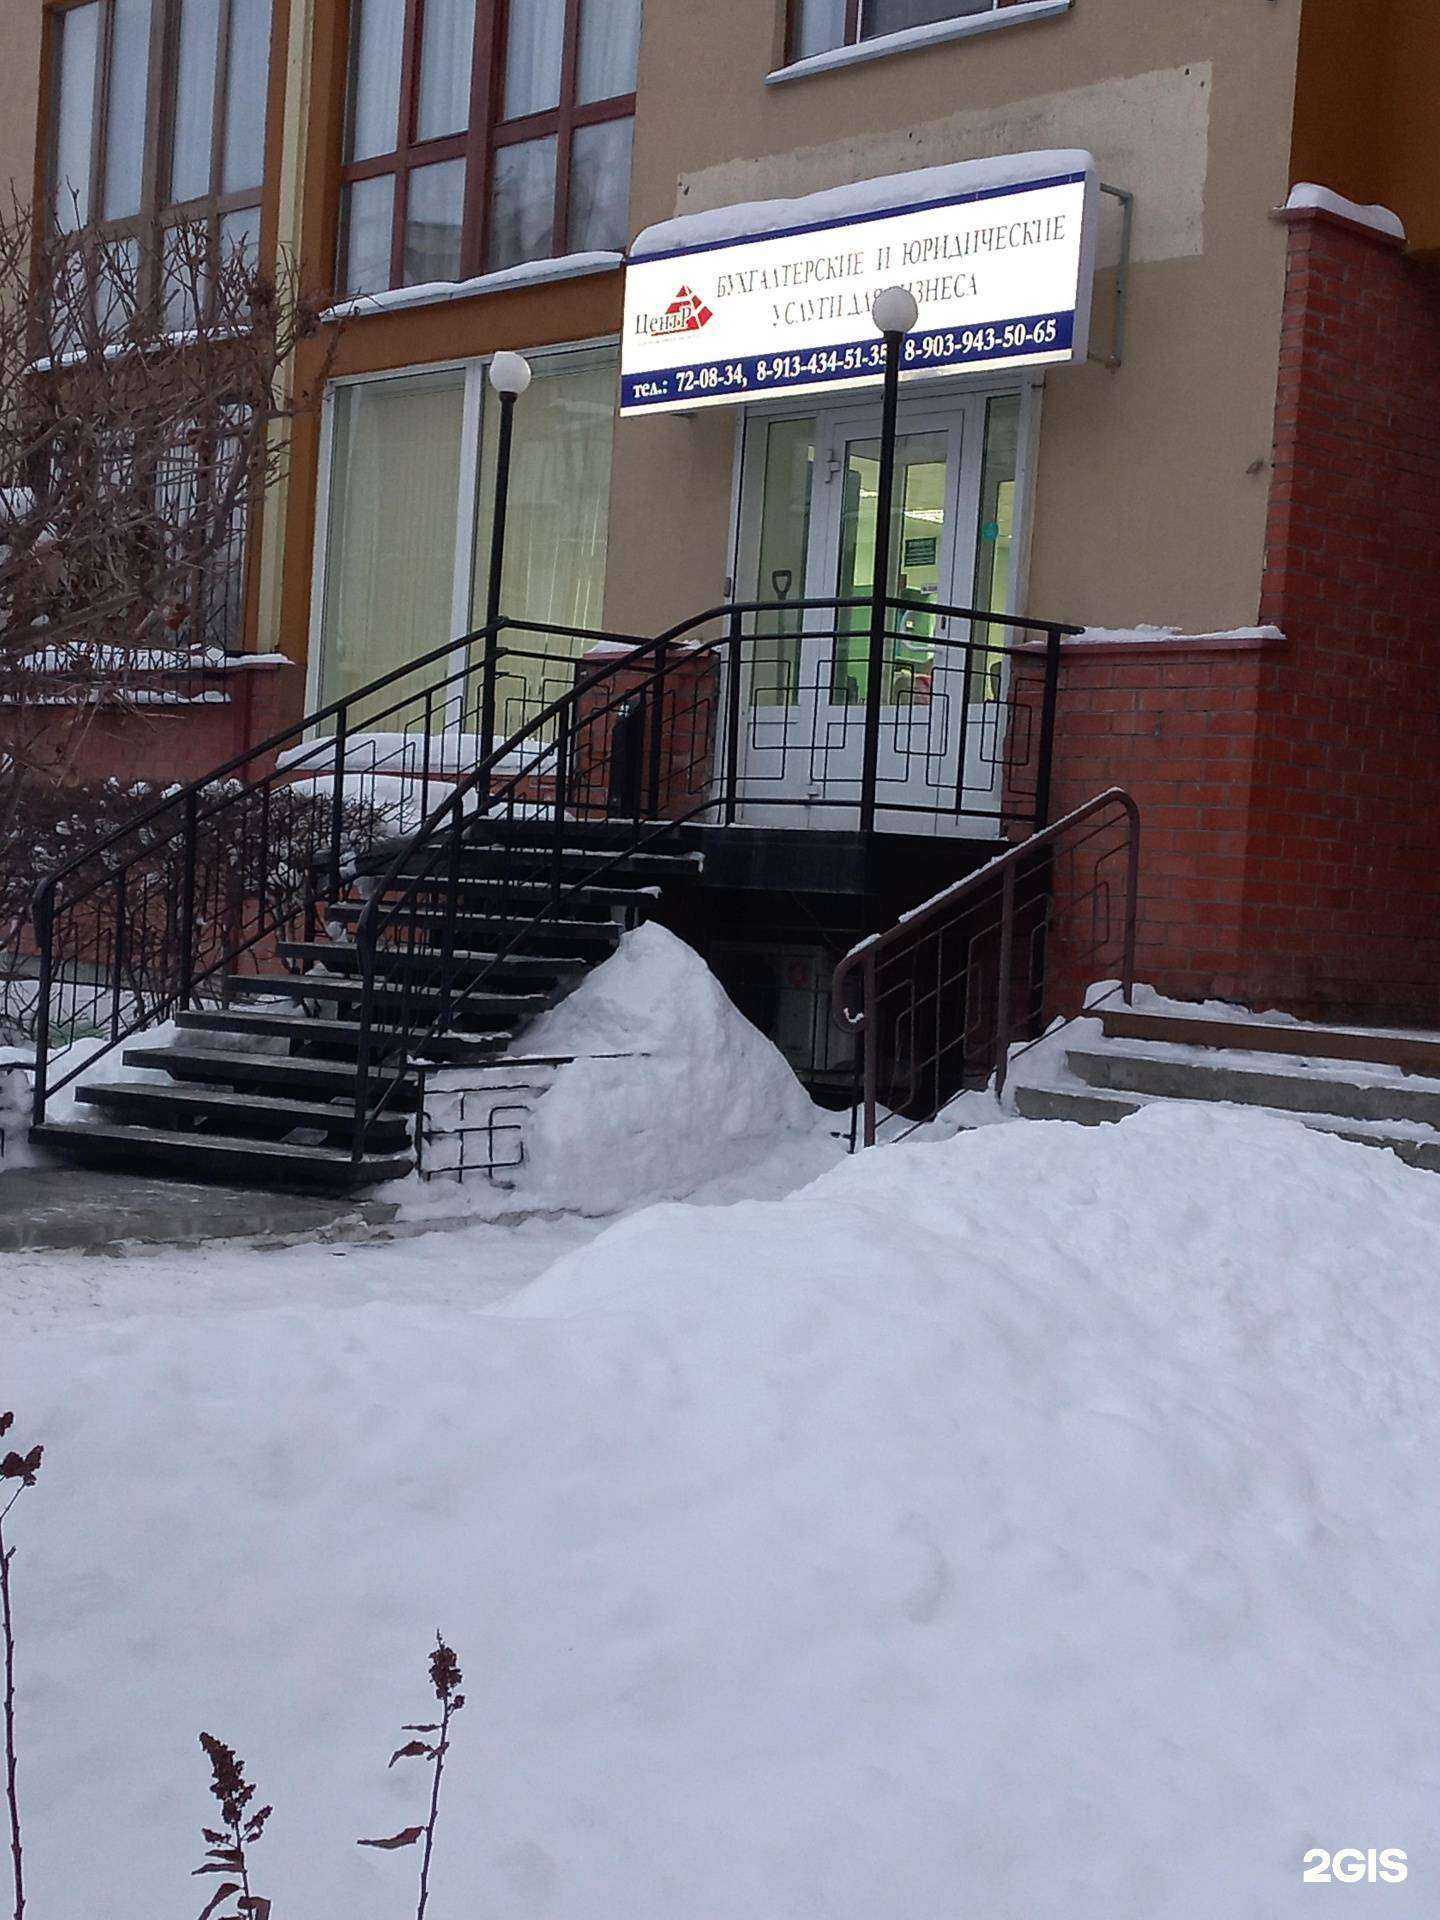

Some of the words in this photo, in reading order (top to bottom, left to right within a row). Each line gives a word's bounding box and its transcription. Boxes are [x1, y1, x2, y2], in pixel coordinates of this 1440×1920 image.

[716, 250, 864, 298] БУХГАЛТЕРСКИЕ
[876, 246, 891, 271] И
[902, 214, 1066, 266] ЮРИДИЧЕСКИЕ
[772, 294, 842, 327] УСЛУГИ
[898, 272, 978, 304] ЗНЕСА
[632, 380, 669, 398] тел.:
[675, 363, 748, 392] 72-08-34,
[904, 319, 1057, 361] 8-903-943-50-65
